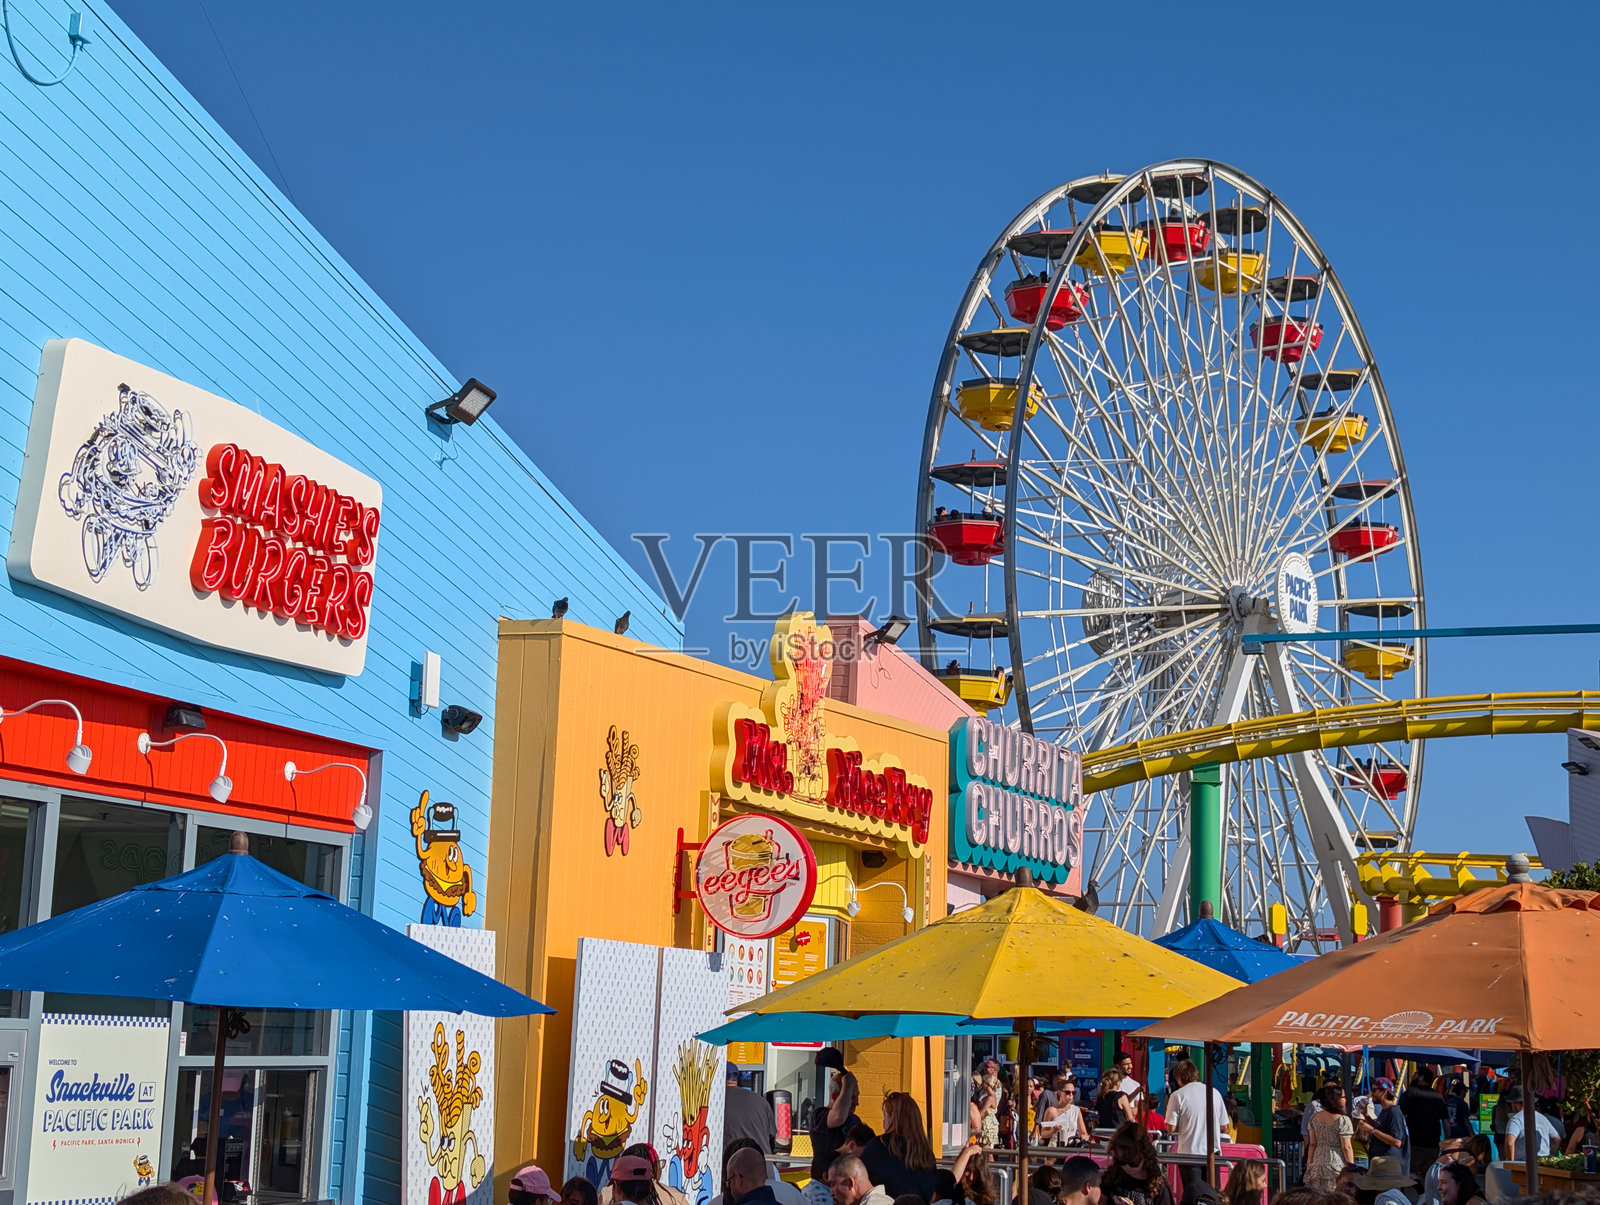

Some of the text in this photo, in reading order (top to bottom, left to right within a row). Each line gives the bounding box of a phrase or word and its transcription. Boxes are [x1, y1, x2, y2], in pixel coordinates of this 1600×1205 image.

[198, 443, 380, 566] SMASHIE'S
[190, 518, 373, 640] BURGERS
[1285, 573, 1311, 602] PACIFIC
[1289, 598, 1308, 624] PARK
[966, 716, 1083, 806] CHURRITA
[826, 748, 888, 819] Nice
[884, 766, 933, 844] Fry
[965, 781, 1082, 869] CHURROS
[704, 857, 800, 904] eegee's
[1276, 1010, 1504, 1033] PACIFIC PARK
[1309, 1030, 1352, 1039] SANTA
[1358, 1032, 1411, 1040] MONICA
[46, 1069, 153, 1103] Snackville AT
[43, 1108, 155, 1133] PACIFIC PARK
